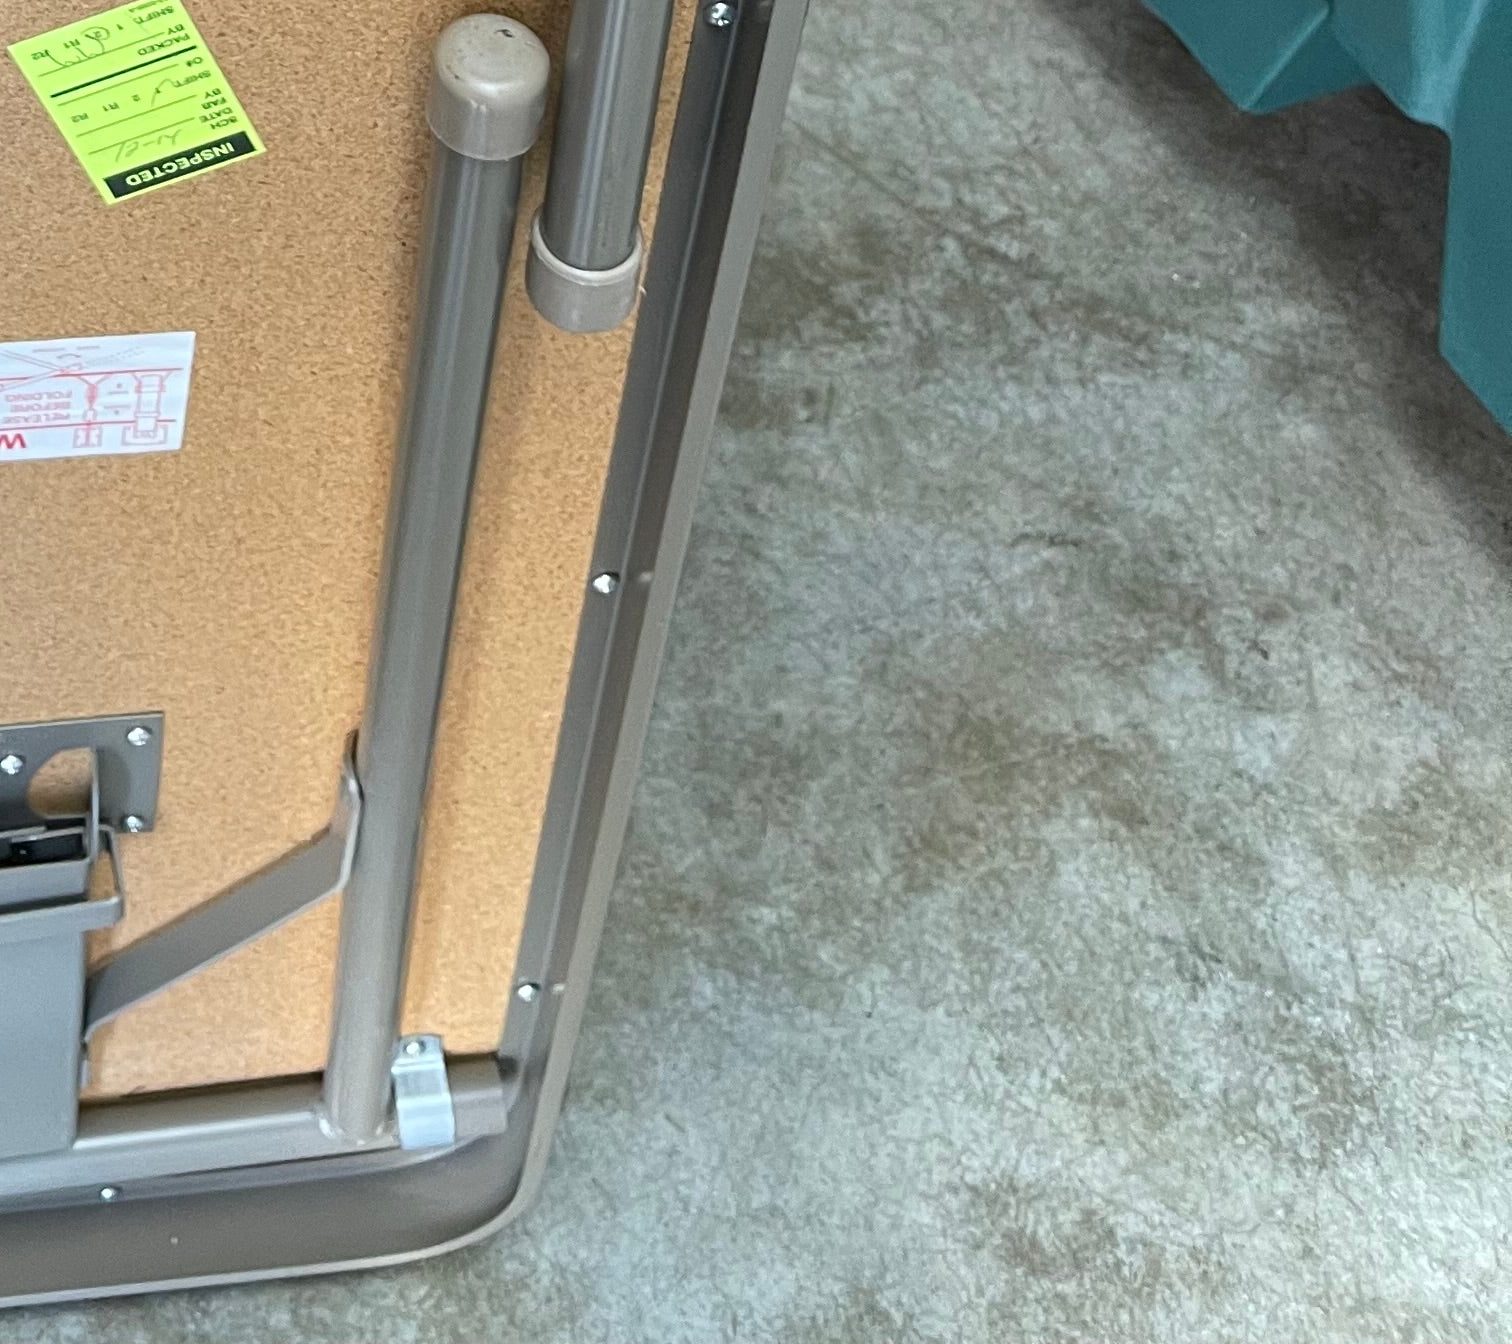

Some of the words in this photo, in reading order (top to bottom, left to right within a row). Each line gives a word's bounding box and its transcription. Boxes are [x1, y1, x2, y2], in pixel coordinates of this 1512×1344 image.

[167, 24, 185, 35] BY
[64, 39, 81, 49] R1
[136, 32, 190, 56] PACKED
[203, 88, 222, 99] BY
[102, 102, 120, 112] R1
[71, 113, 89, 123] R2
[199, 107, 233, 123] DATE
[125, 142, 235, 187] INSPECTED
[5, 391, 72, 402] FOLDING
[10, 401, 71, 413] BEFORE
[2, 413, 71, 424] RELEASE
